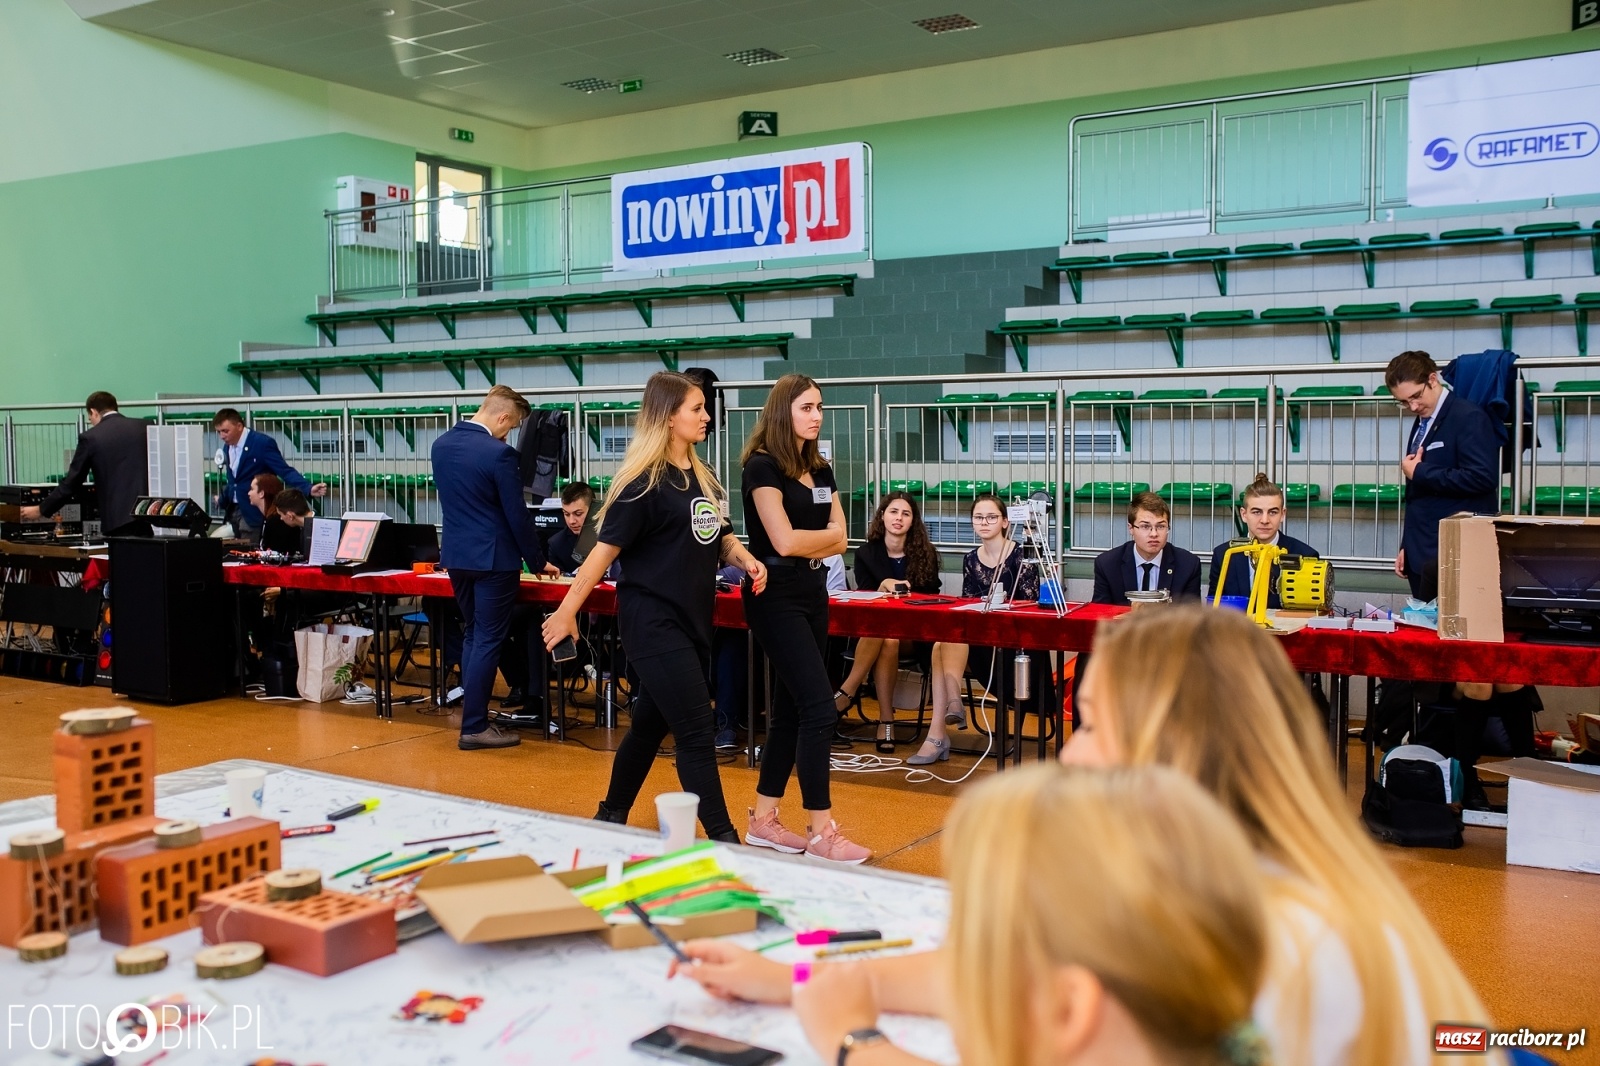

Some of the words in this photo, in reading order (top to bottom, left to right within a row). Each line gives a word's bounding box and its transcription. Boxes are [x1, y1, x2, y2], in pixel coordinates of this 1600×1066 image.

[1579, 2, 1598, 24] B
[749, 119, 773, 134] A
[1478, 131, 1588, 160] RAFAMET
[626, 160, 839, 246] nowiny.pl
[534, 514, 558, 523] eltron
